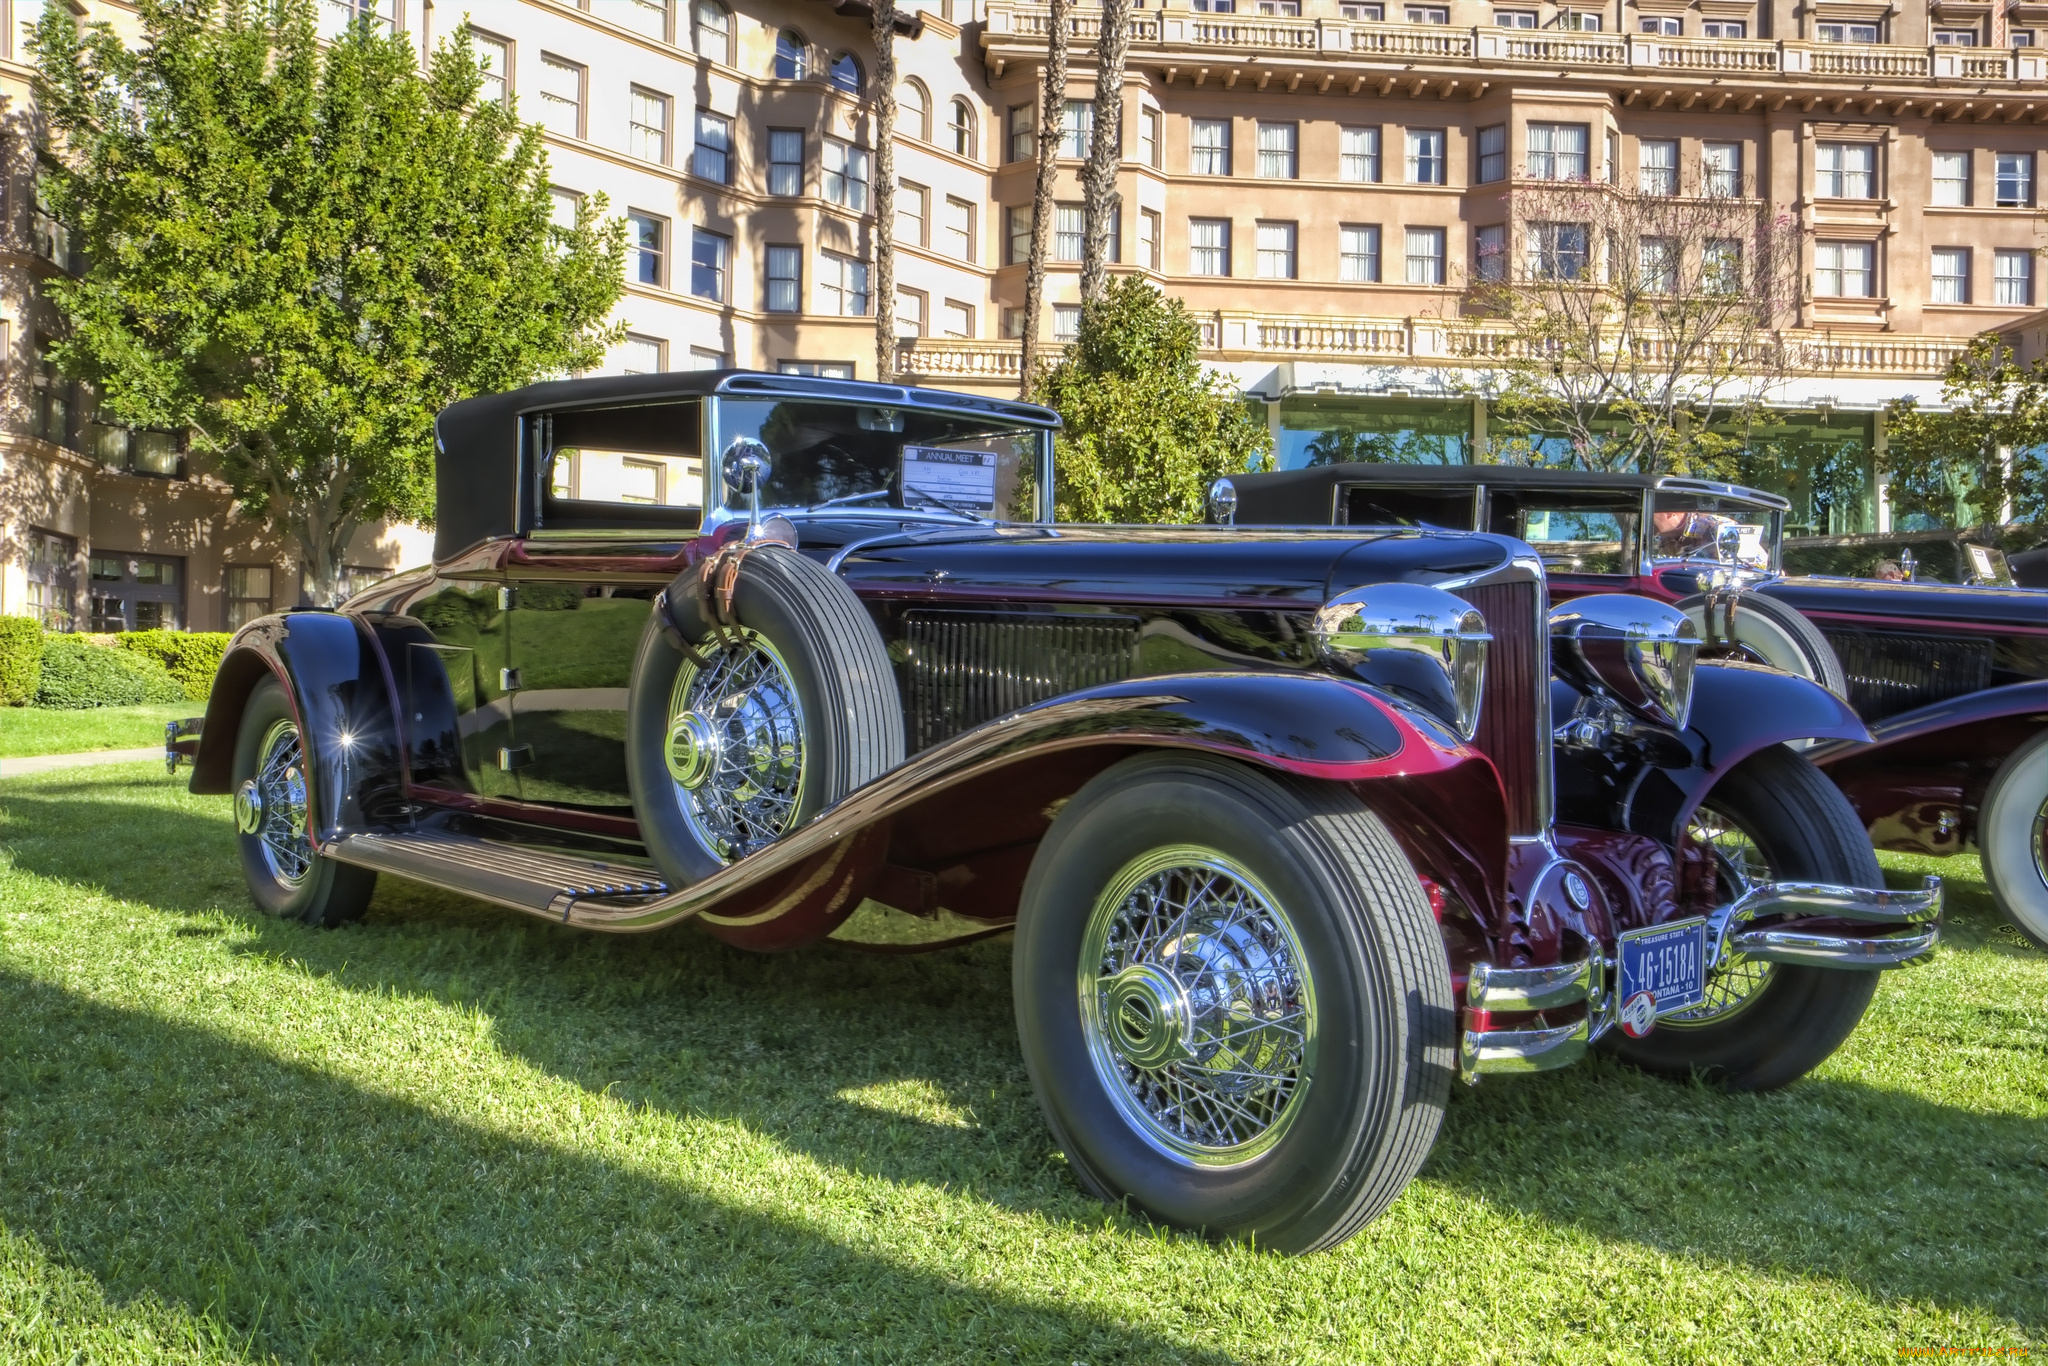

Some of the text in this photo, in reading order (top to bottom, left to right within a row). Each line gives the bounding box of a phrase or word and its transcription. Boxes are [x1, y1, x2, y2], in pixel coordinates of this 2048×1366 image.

[926, 452, 955, 462] ANNUAL
[955, 454, 974, 463] MEET
[1641, 933, 1668, 945] TREASURE
[1669, 930, 1684, 939] STATE
[1652, 984, 1680, 999] ONTANA
